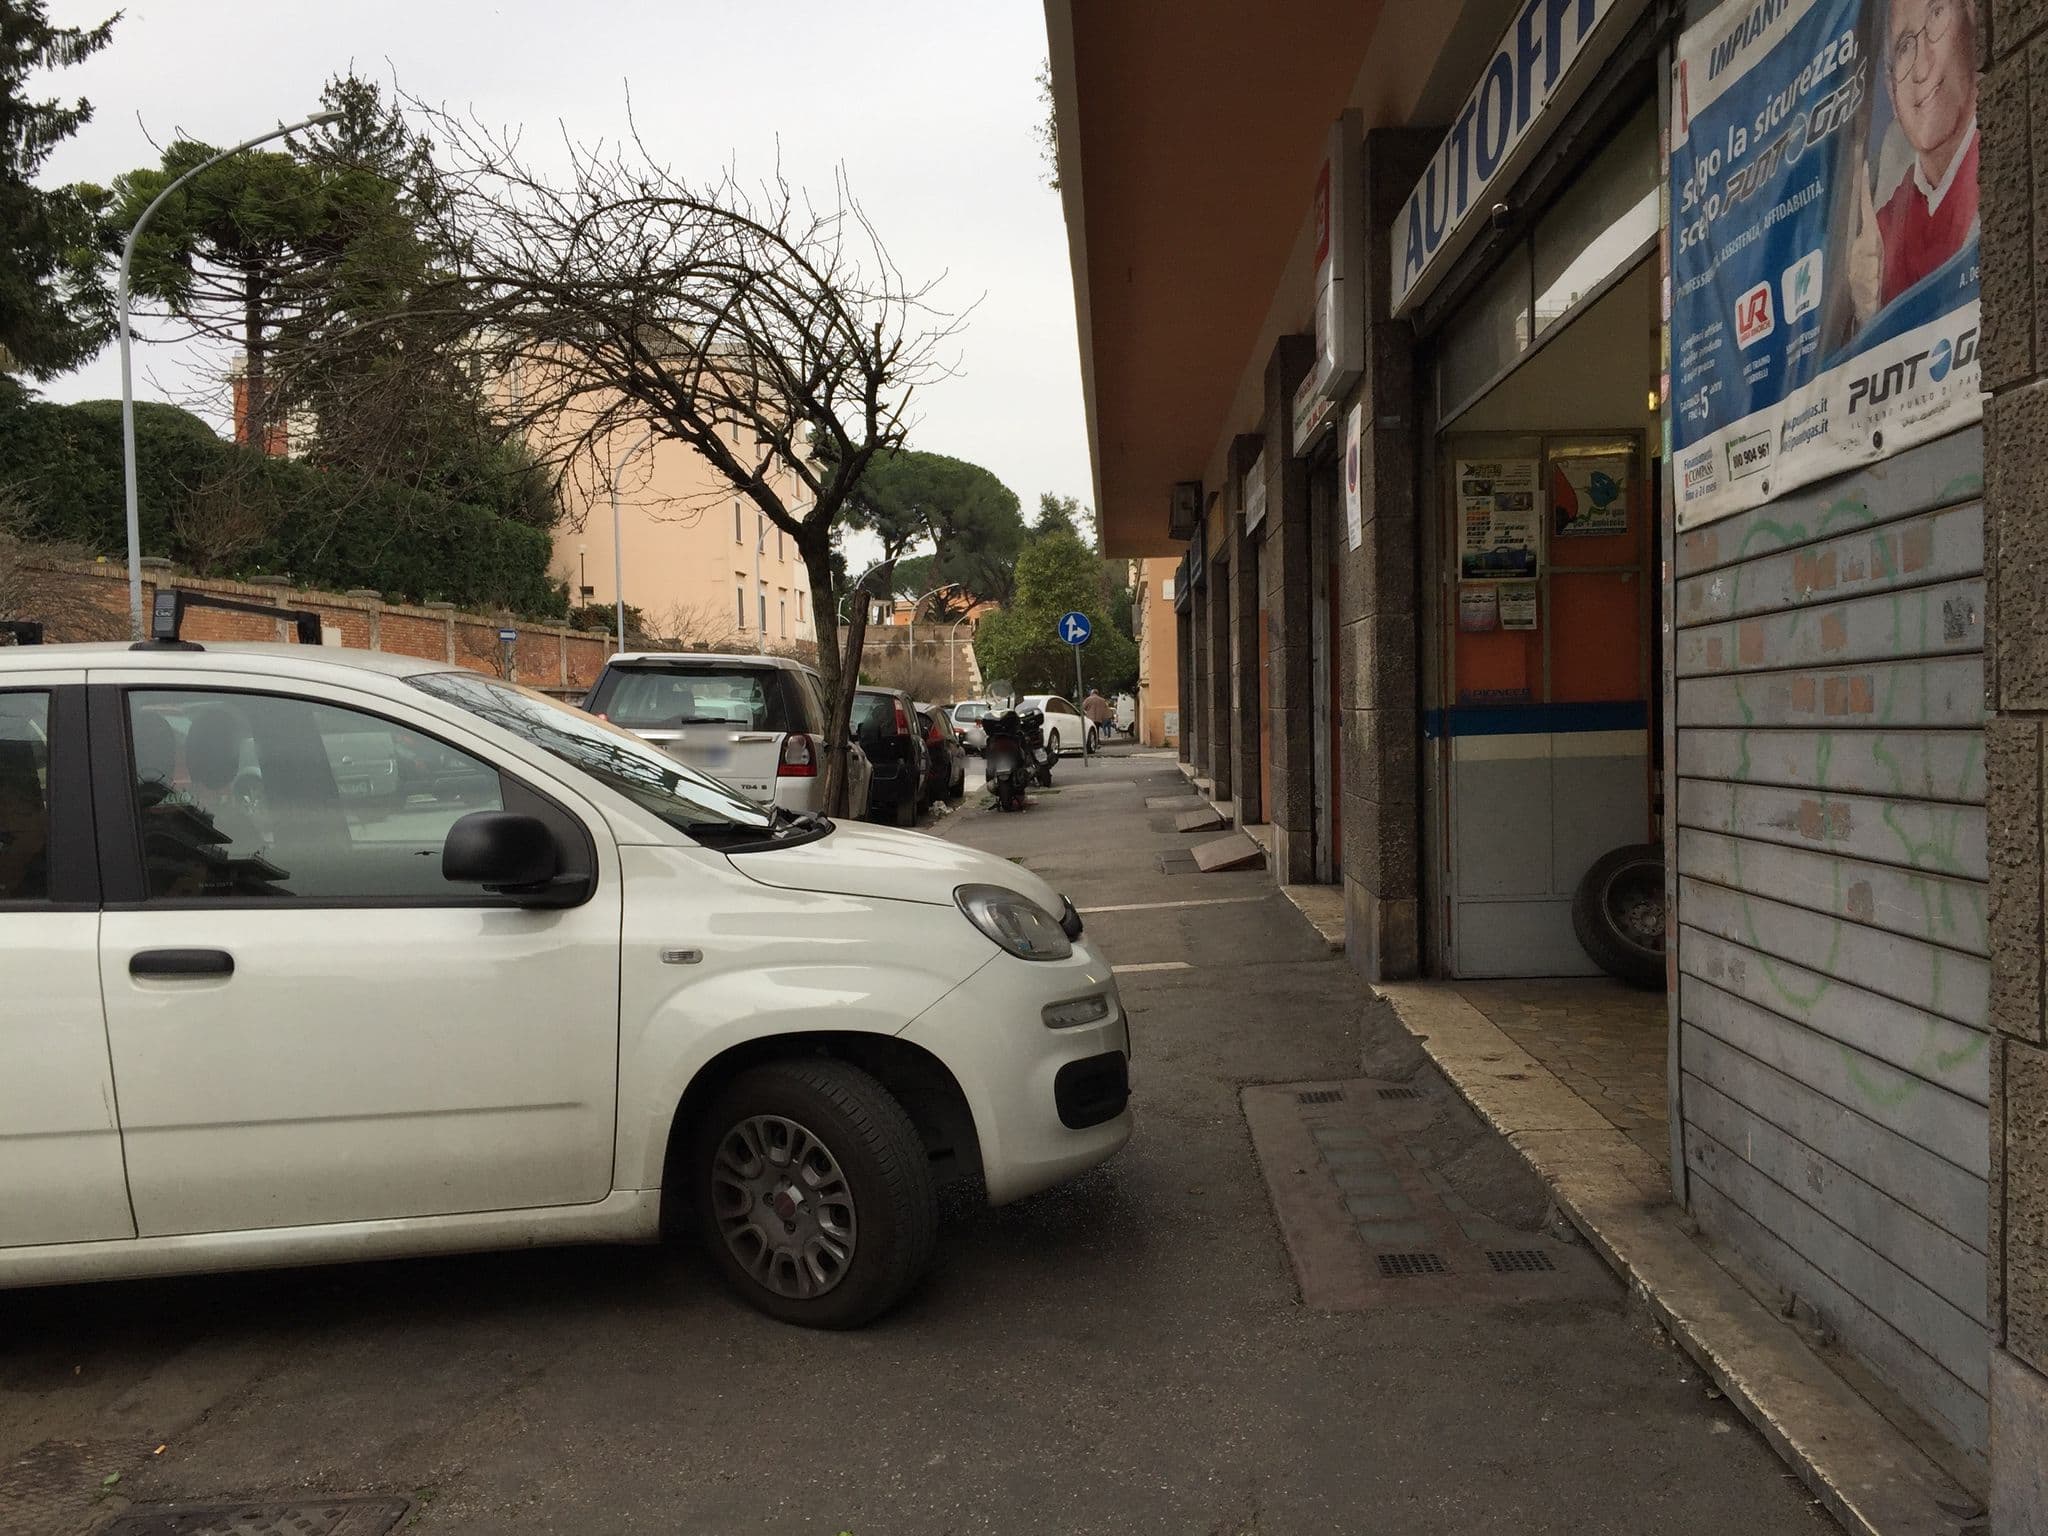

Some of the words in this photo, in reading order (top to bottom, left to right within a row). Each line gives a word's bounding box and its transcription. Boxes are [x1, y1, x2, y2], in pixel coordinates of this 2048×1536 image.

[1708, 0, 1788, 81] IMPIAN
[1727, 124, 1747, 163] la
[1753, 29, 1859, 144] sicurezza,
[1848, 326, 1981, 415] PUNTOG
